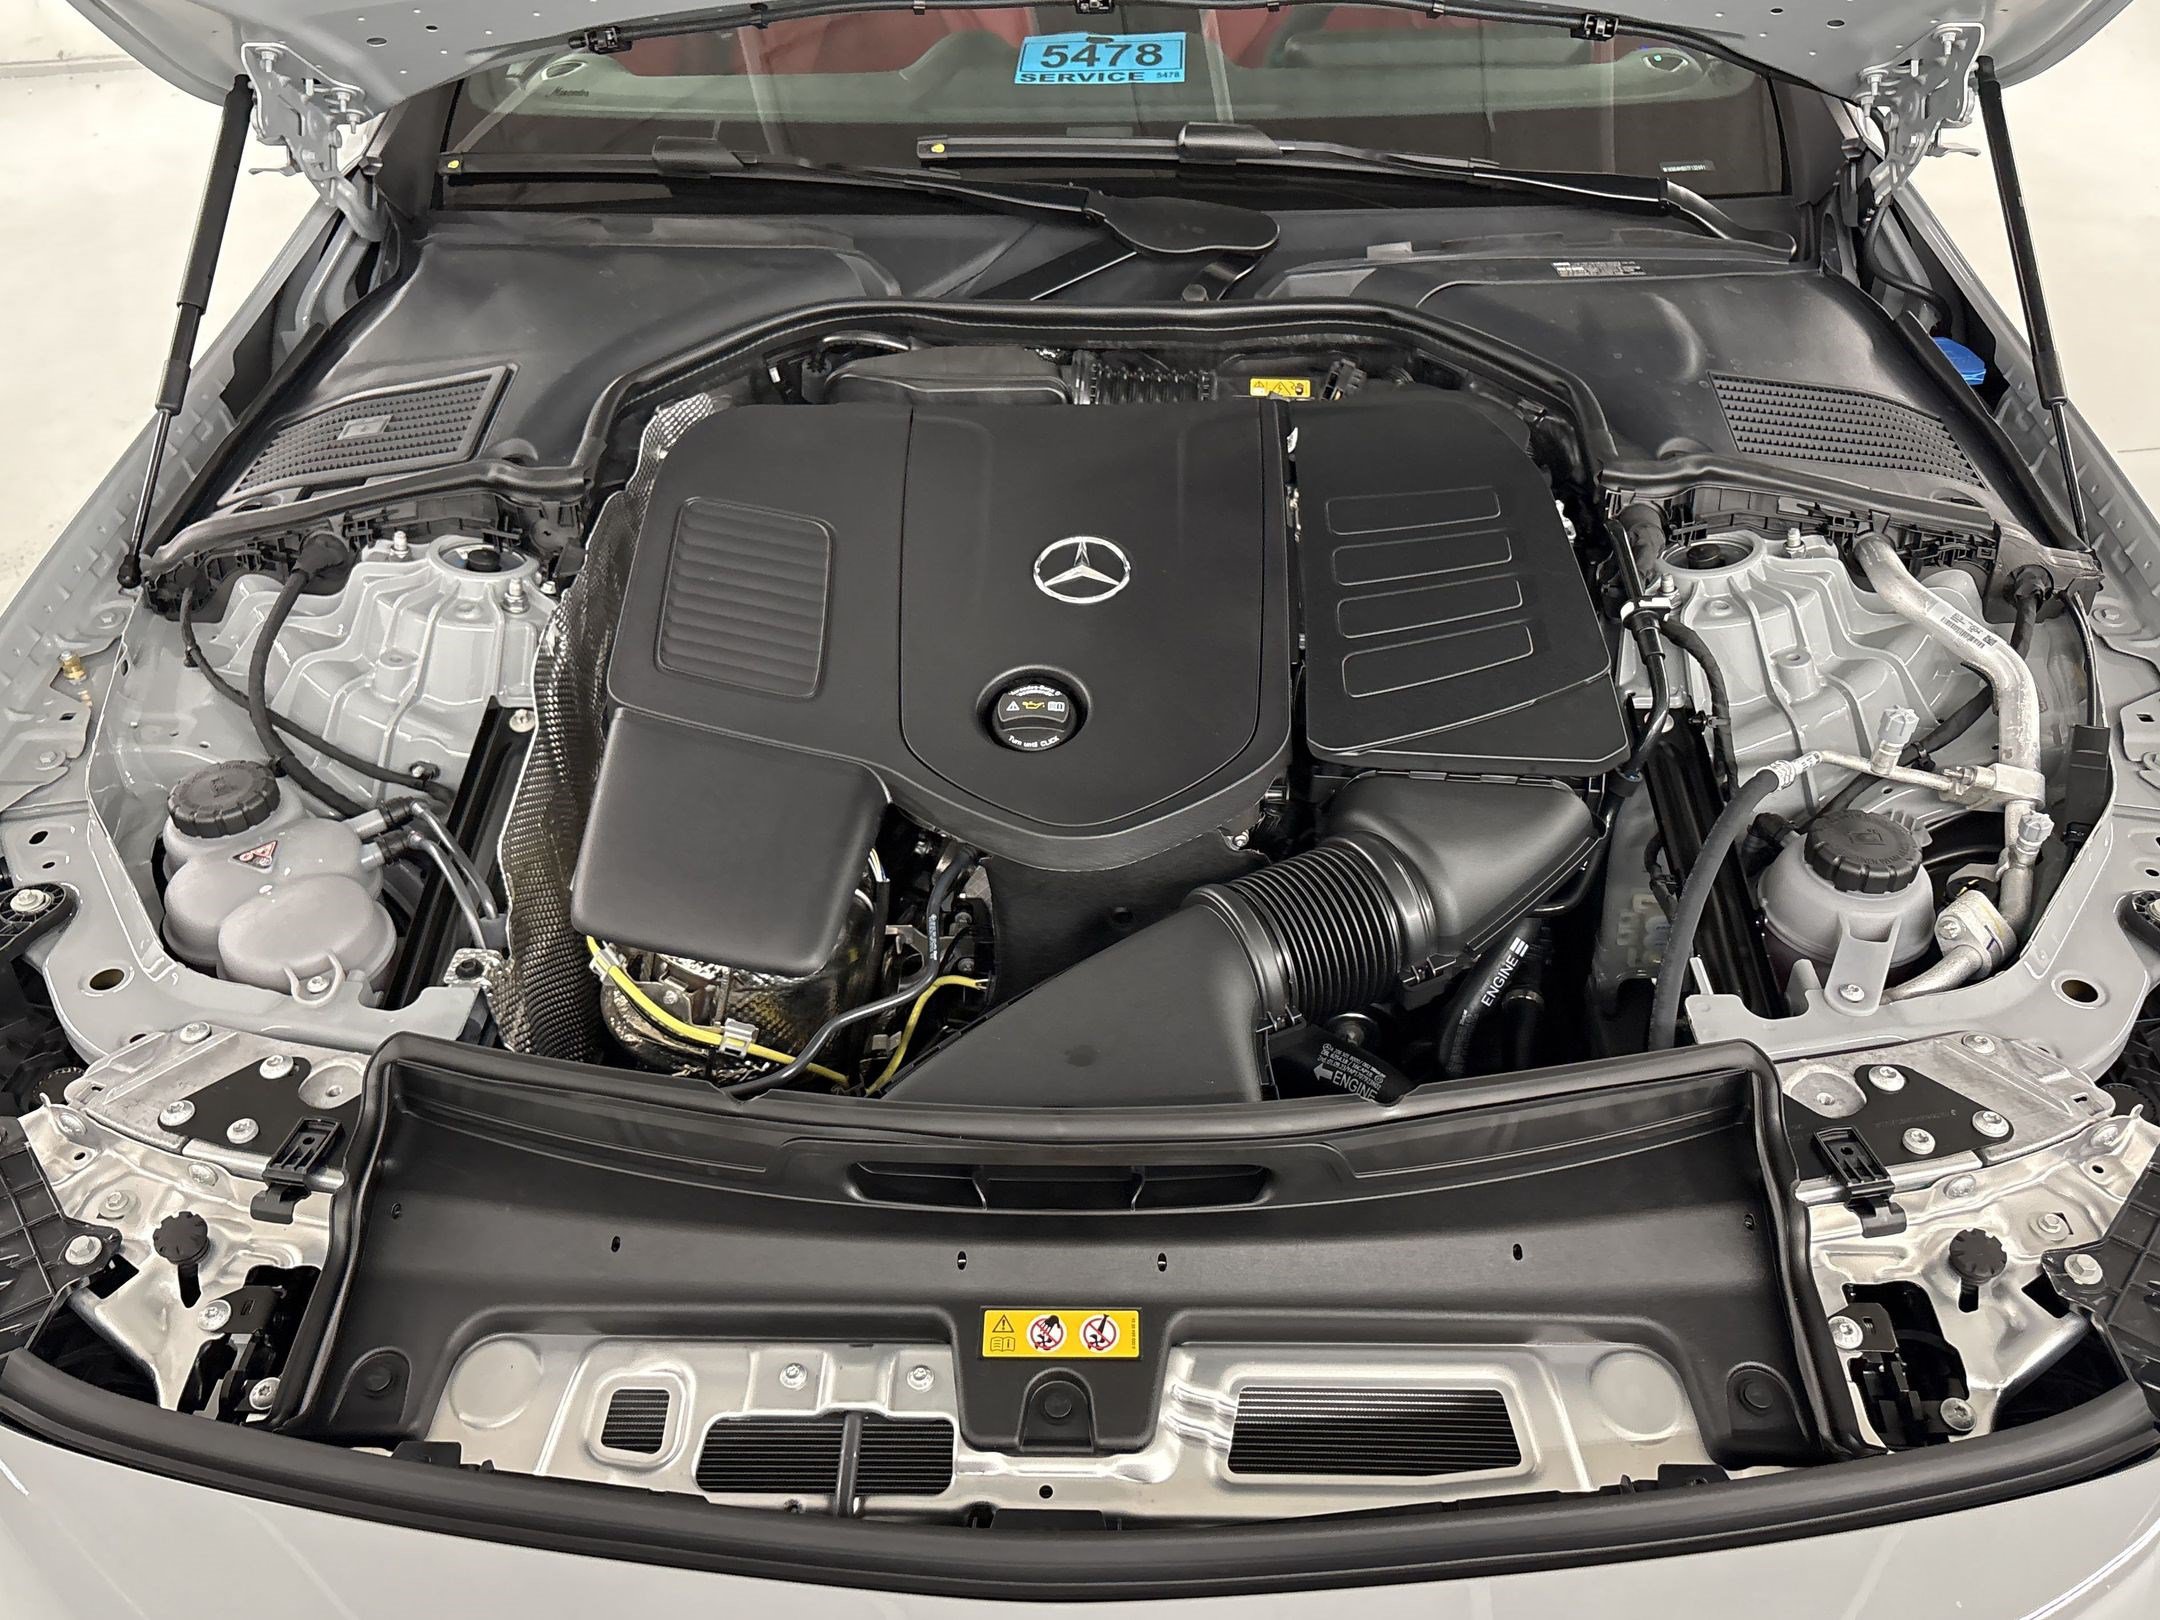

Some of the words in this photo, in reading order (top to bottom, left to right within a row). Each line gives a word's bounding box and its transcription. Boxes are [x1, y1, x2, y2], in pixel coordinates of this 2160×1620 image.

[1040, 43, 1163, 68] 5478
[1020, 72, 1145, 83] SERVICE
[1156, 71, 1180, 79] 5478
[1008, 735, 1022, 746] Turn
[1481, 954, 1519, 1007] ENGINE
[1332, 1070, 1378, 1099] ENGINE
